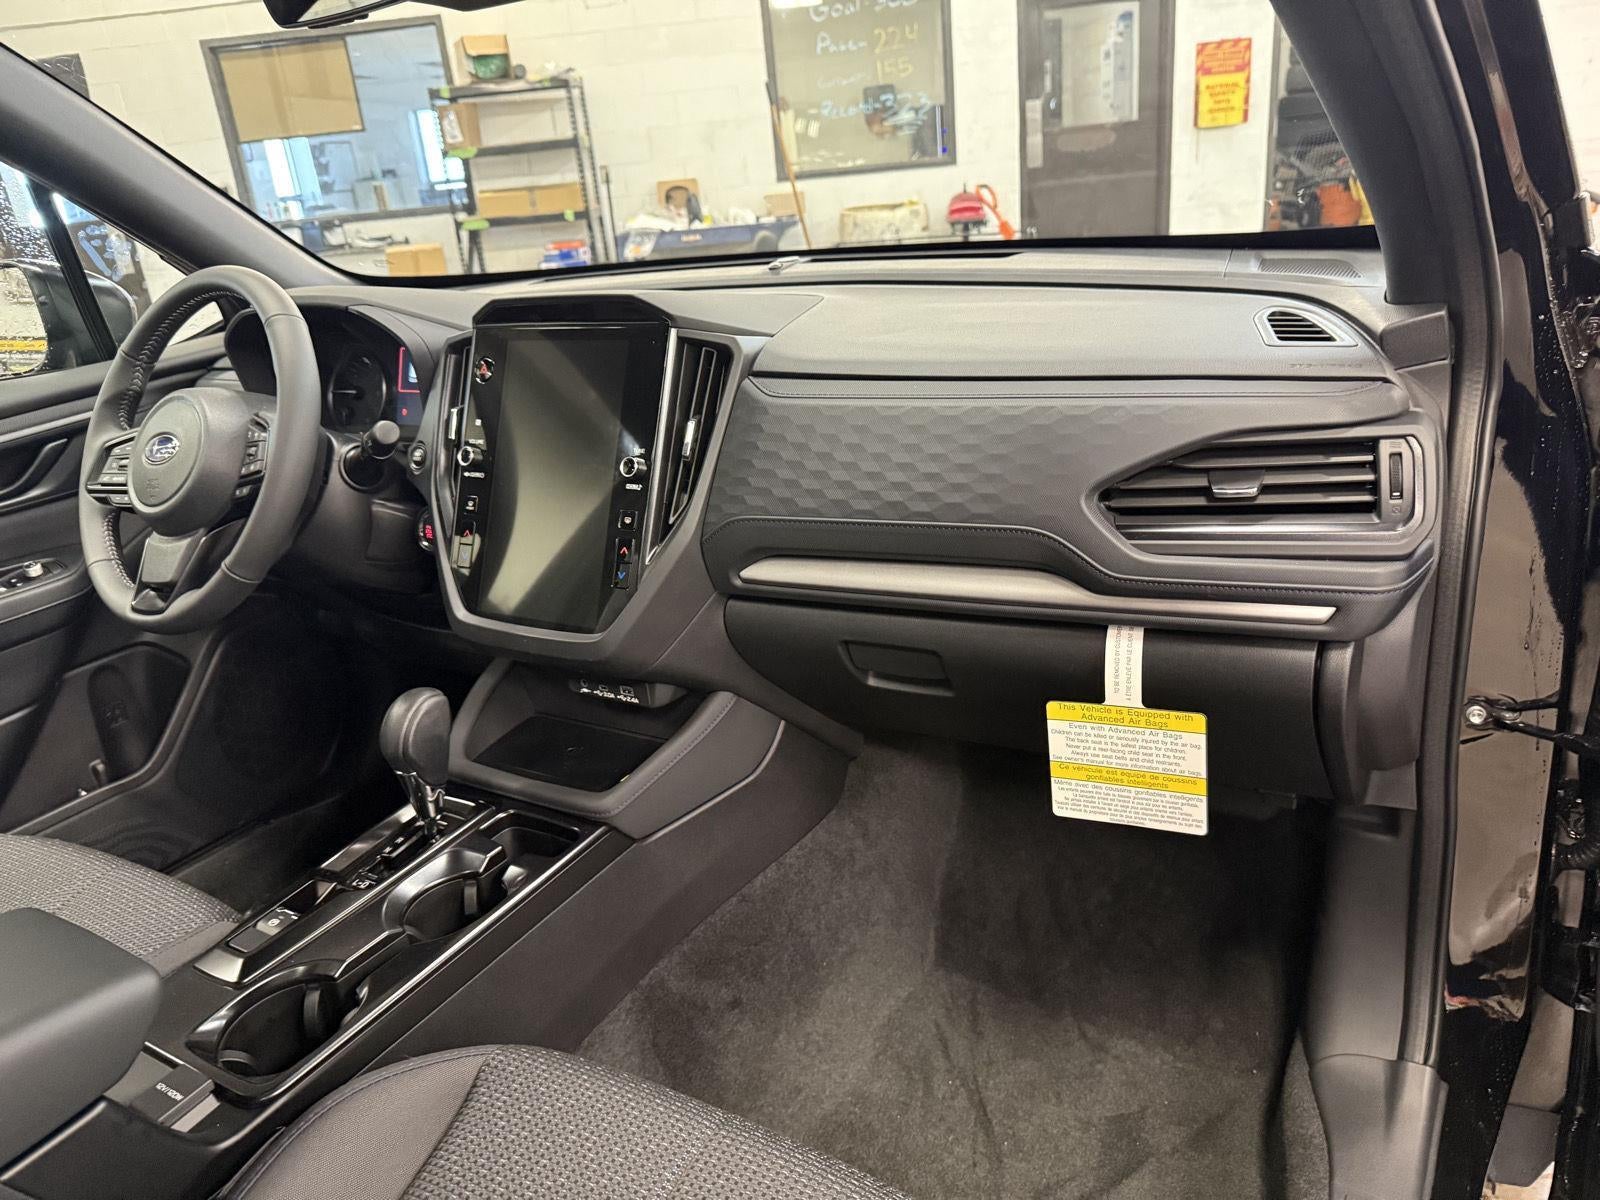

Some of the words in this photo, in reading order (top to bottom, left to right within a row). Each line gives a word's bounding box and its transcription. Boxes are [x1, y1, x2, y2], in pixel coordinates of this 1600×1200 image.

[1057, 703, 1076, 711] This
[1080, 705, 1112, 714] Vehicle
[1127, 709, 1170, 720] Equipped
[1174, 713, 1194, 722] with
[1081, 713, 1125, 724] Advanced
[1128, 717, 1141, 725] Air
[1145, 719, 1168, 729] Bags
[1068, 722, 1087, 730] Even
[1108, 726, 1145, 736] Advanced
[1163, 732, 1183, 741] Bags
[1162, 776, 1198, 786] coussins
